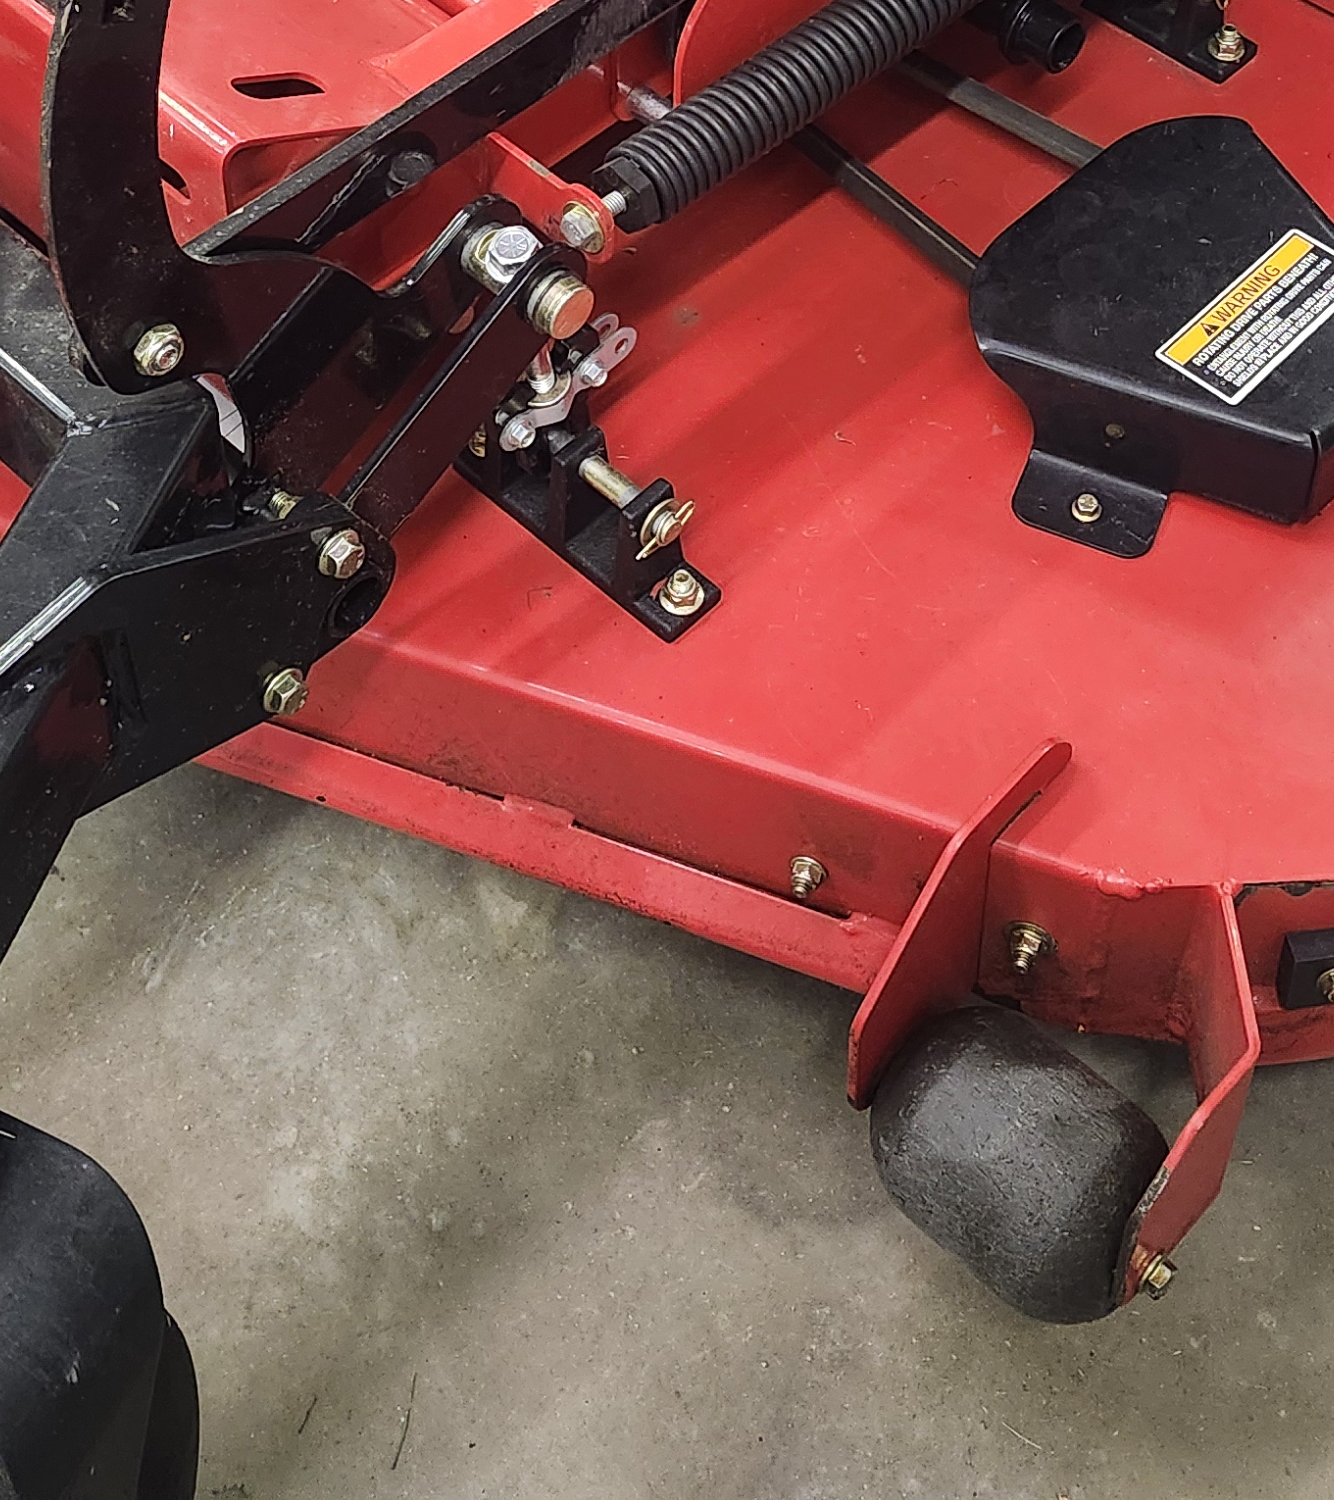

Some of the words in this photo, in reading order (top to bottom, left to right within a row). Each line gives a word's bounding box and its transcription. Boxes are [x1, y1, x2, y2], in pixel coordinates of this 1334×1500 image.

[1191, 328, 1235, 367] ROTATING
[1229, 307, 1258, 332] DRIVE
[1252, 284, 1283, 310] PARTS
[1277, 252, 1319, 288] BENEATH!
[1210, 262, 1282, 324] WARNING
[1242, 338, 1272, 364] OPERATE
[1311, 287, 1327, 299] ALL
[1259, 341, 1282, 361] PLACE
